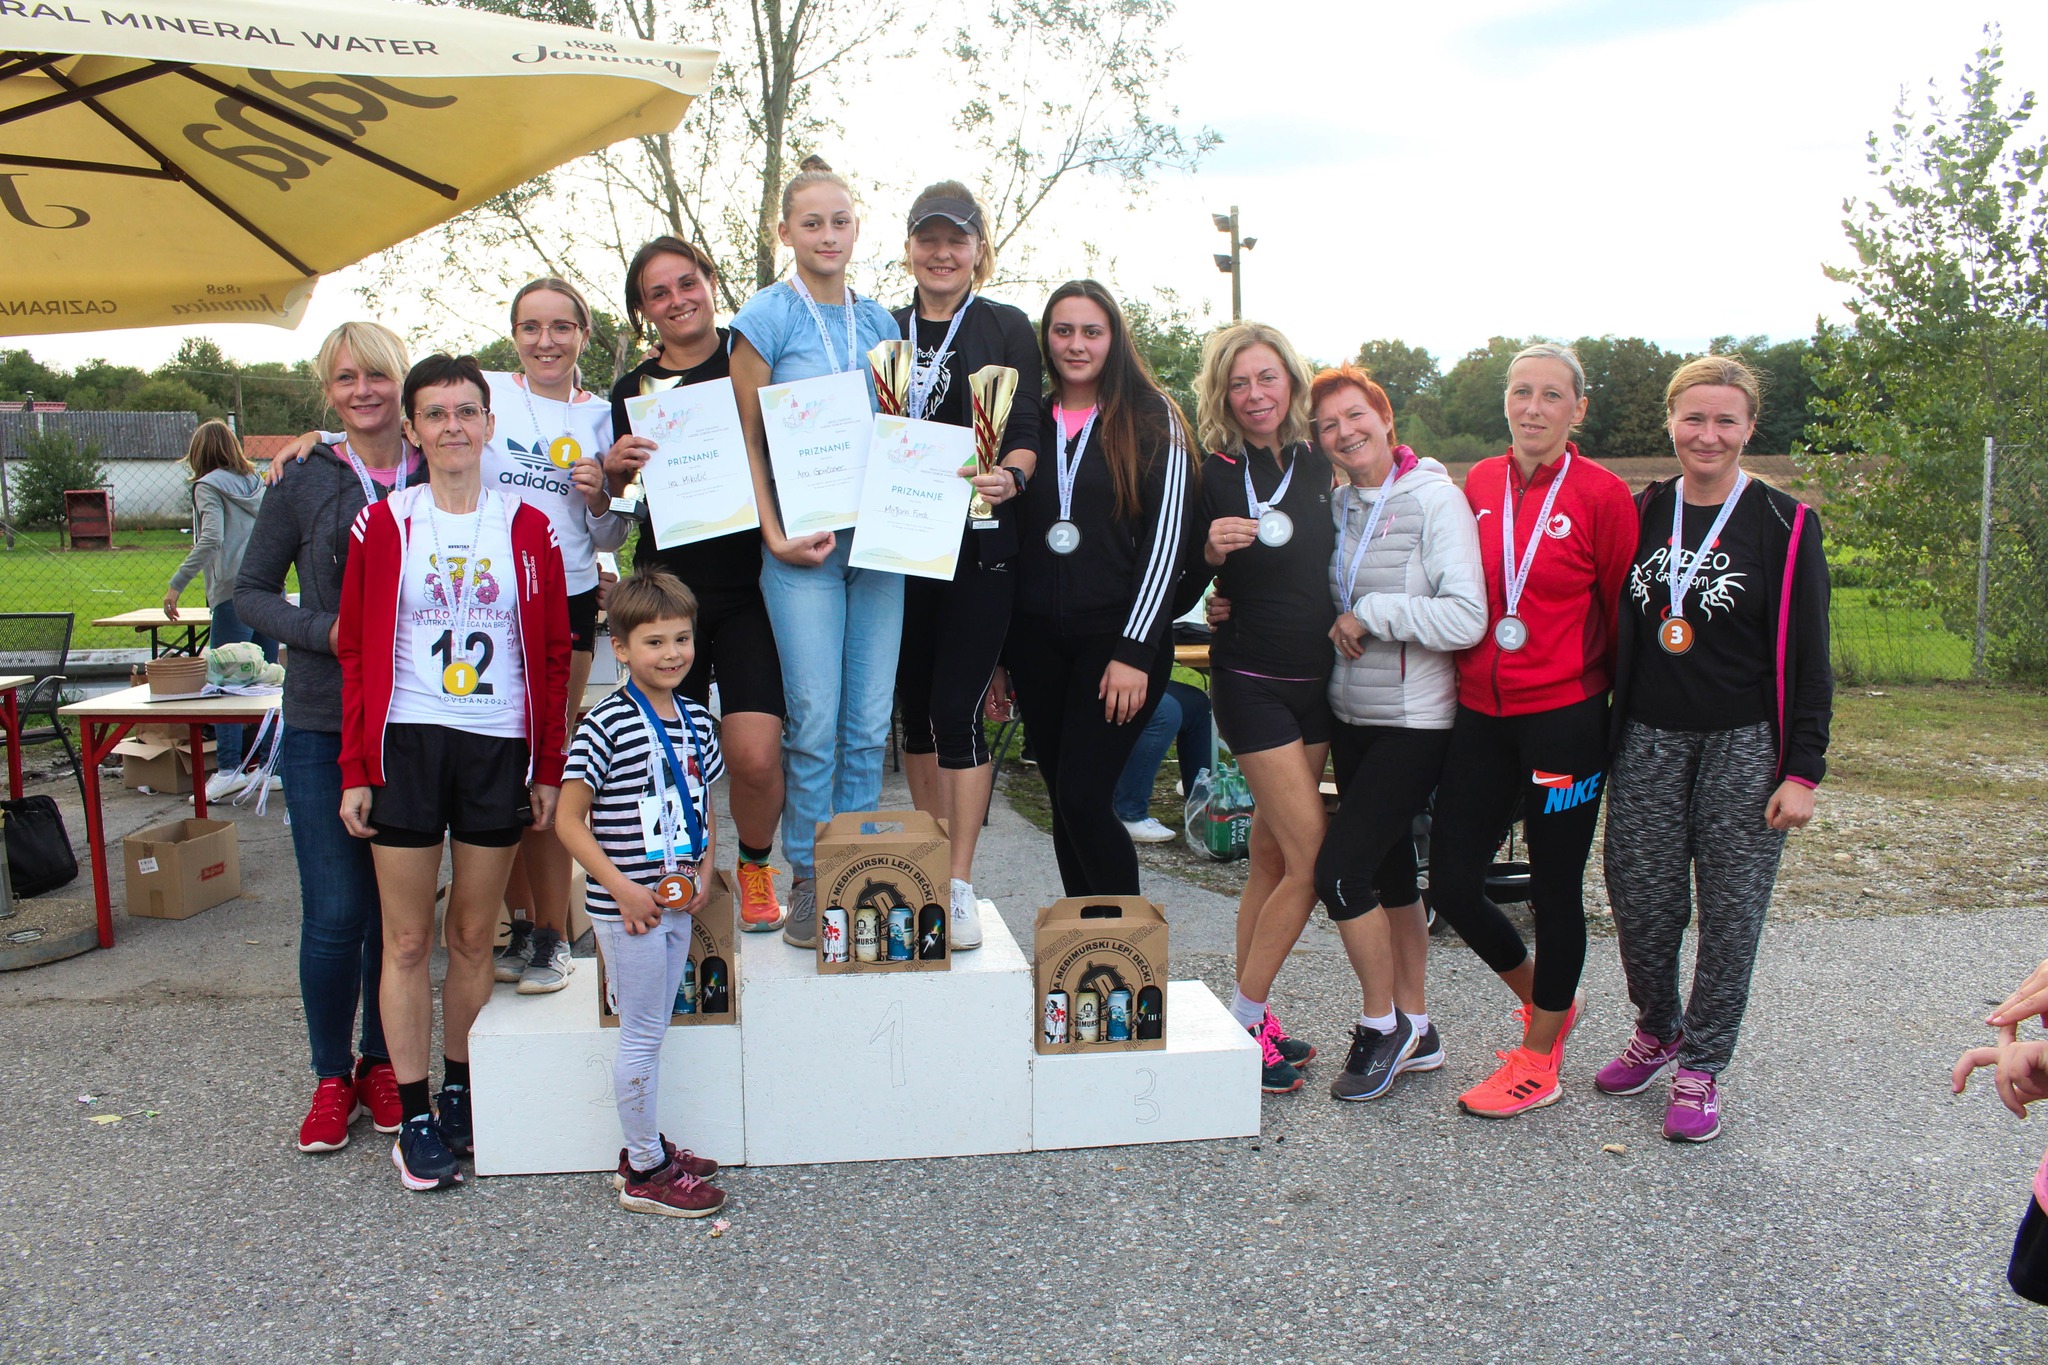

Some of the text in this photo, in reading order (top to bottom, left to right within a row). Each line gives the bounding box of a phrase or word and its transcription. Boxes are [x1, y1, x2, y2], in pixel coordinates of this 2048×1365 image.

[101, 10, 295, 46] MINERAL
[301, 31, 440, 56] WATER
[565, 41, 617, 53] 1828
[561, 444, 571, 461] 1
[667, 450, 719, 466] PRIZNANJE
[799, 441, 851, 457] PRIZNANJE
[499, 472, 570, 495] adidas
[891, 485, 943, 501] PRIZNANJE
[1056, 529, 1070, 547] 2
[1265, 520, 1285, 539] 2
[1503, 626, 1517, 644] 2
[1670, 626, 1684, 645] 3
[431, 629, 494, 695] 12
[456, 669, 465, 688] 1
[1544, 771, 1602, 814] NIKE
[1238, 819, 1246, 842] PAN
[834, 857, 889, 896] MEĐIMURSKI
[891, 858, 914, 874] LEPI
[913, 871, 934, 901] DEČKI
[666, 882, 683, 901] 3
[693, 924, 715, 954] DEČKI
[1056, 941, 1109, 980] MEĐIMURSKI
[1111, 942, 1134, 956] LEPI
[1132, 953, 1152, 983] DEČKI
[869, 1000, 906, 1088] 1
[1134, 1067, 1161, 1125] 3
